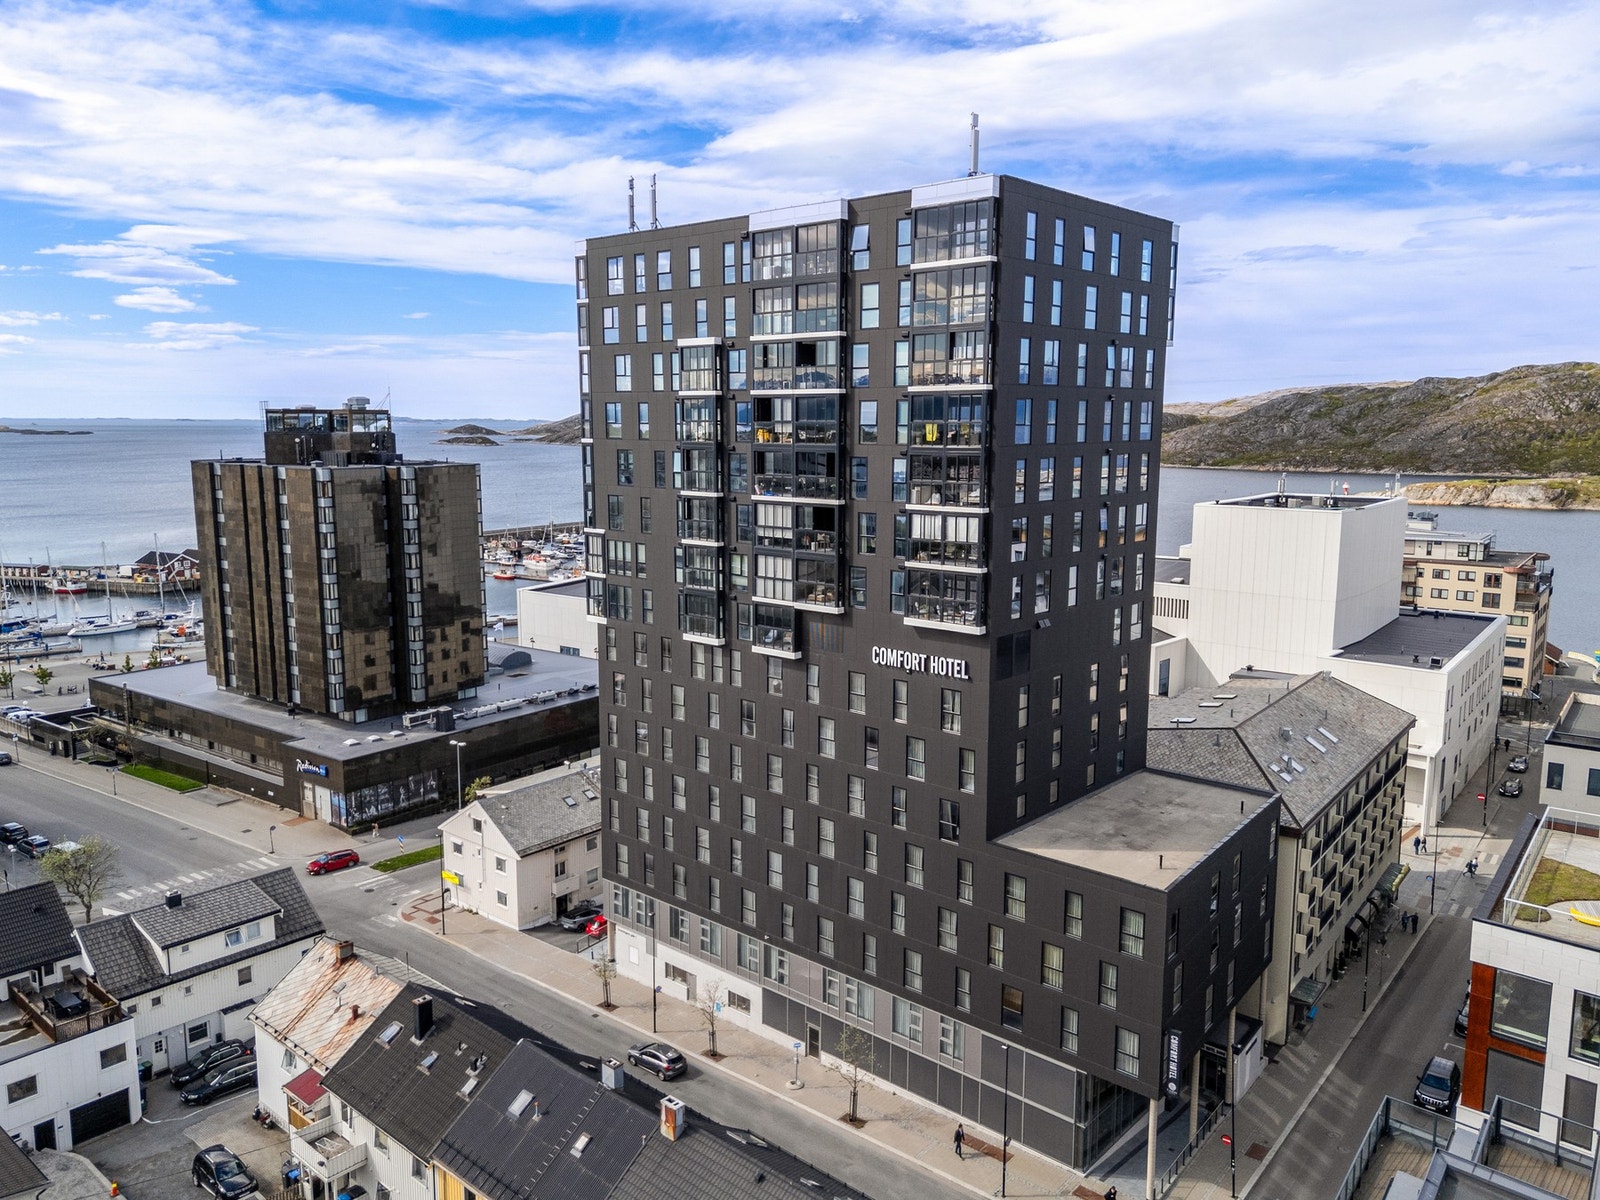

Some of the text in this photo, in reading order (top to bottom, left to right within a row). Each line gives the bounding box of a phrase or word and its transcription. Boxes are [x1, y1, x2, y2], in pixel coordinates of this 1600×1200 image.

[872, 646, 969, 679] COMFORT HOTEL
[1168, 1061, 1178, 1079] HOTEL
